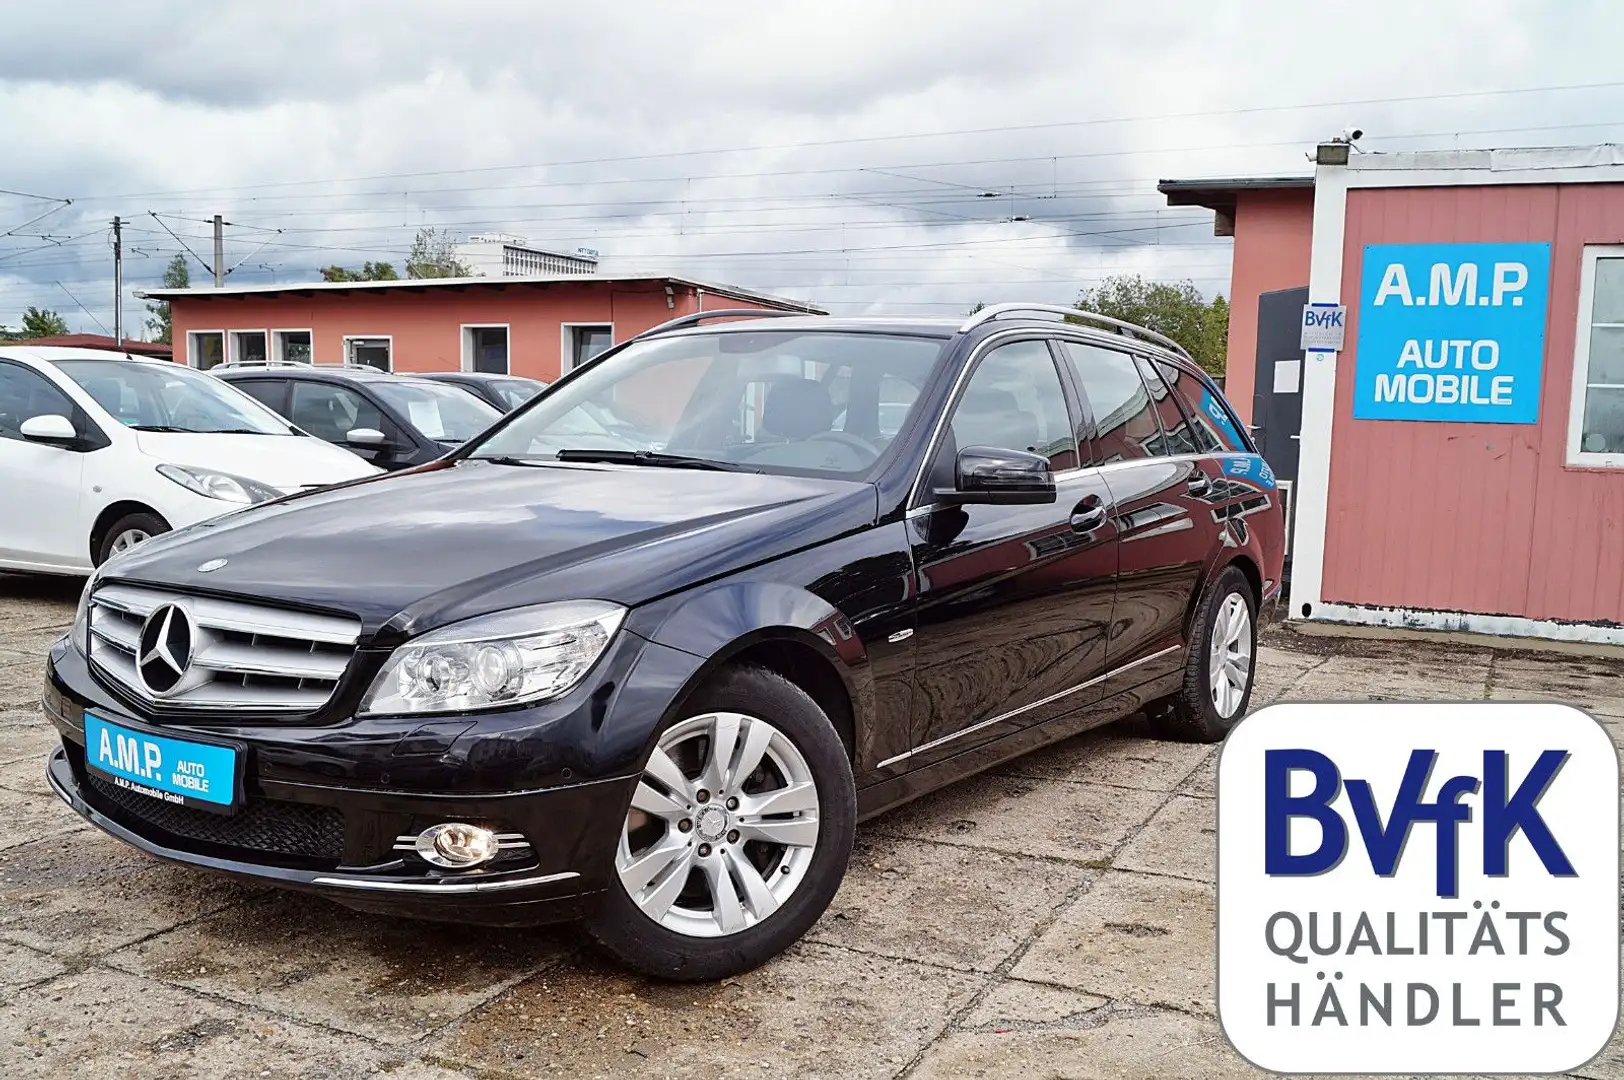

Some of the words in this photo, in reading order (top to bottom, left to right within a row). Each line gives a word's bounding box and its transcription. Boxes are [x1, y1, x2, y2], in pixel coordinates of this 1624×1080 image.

[1373, 262, 1529, 307] A.M.P.
[1396, 339, 1499, 370] AUTO
[1374, 374, 1514, 405] MOBILE
[100, 727, 162, 782] A.M.P.
[176, 760, 205, 777] AUTO
[130, 782, 163, 800] Automobile
[164, 792, 184, 805] GmbH
[172, 773, 209, 793] MOBILE
